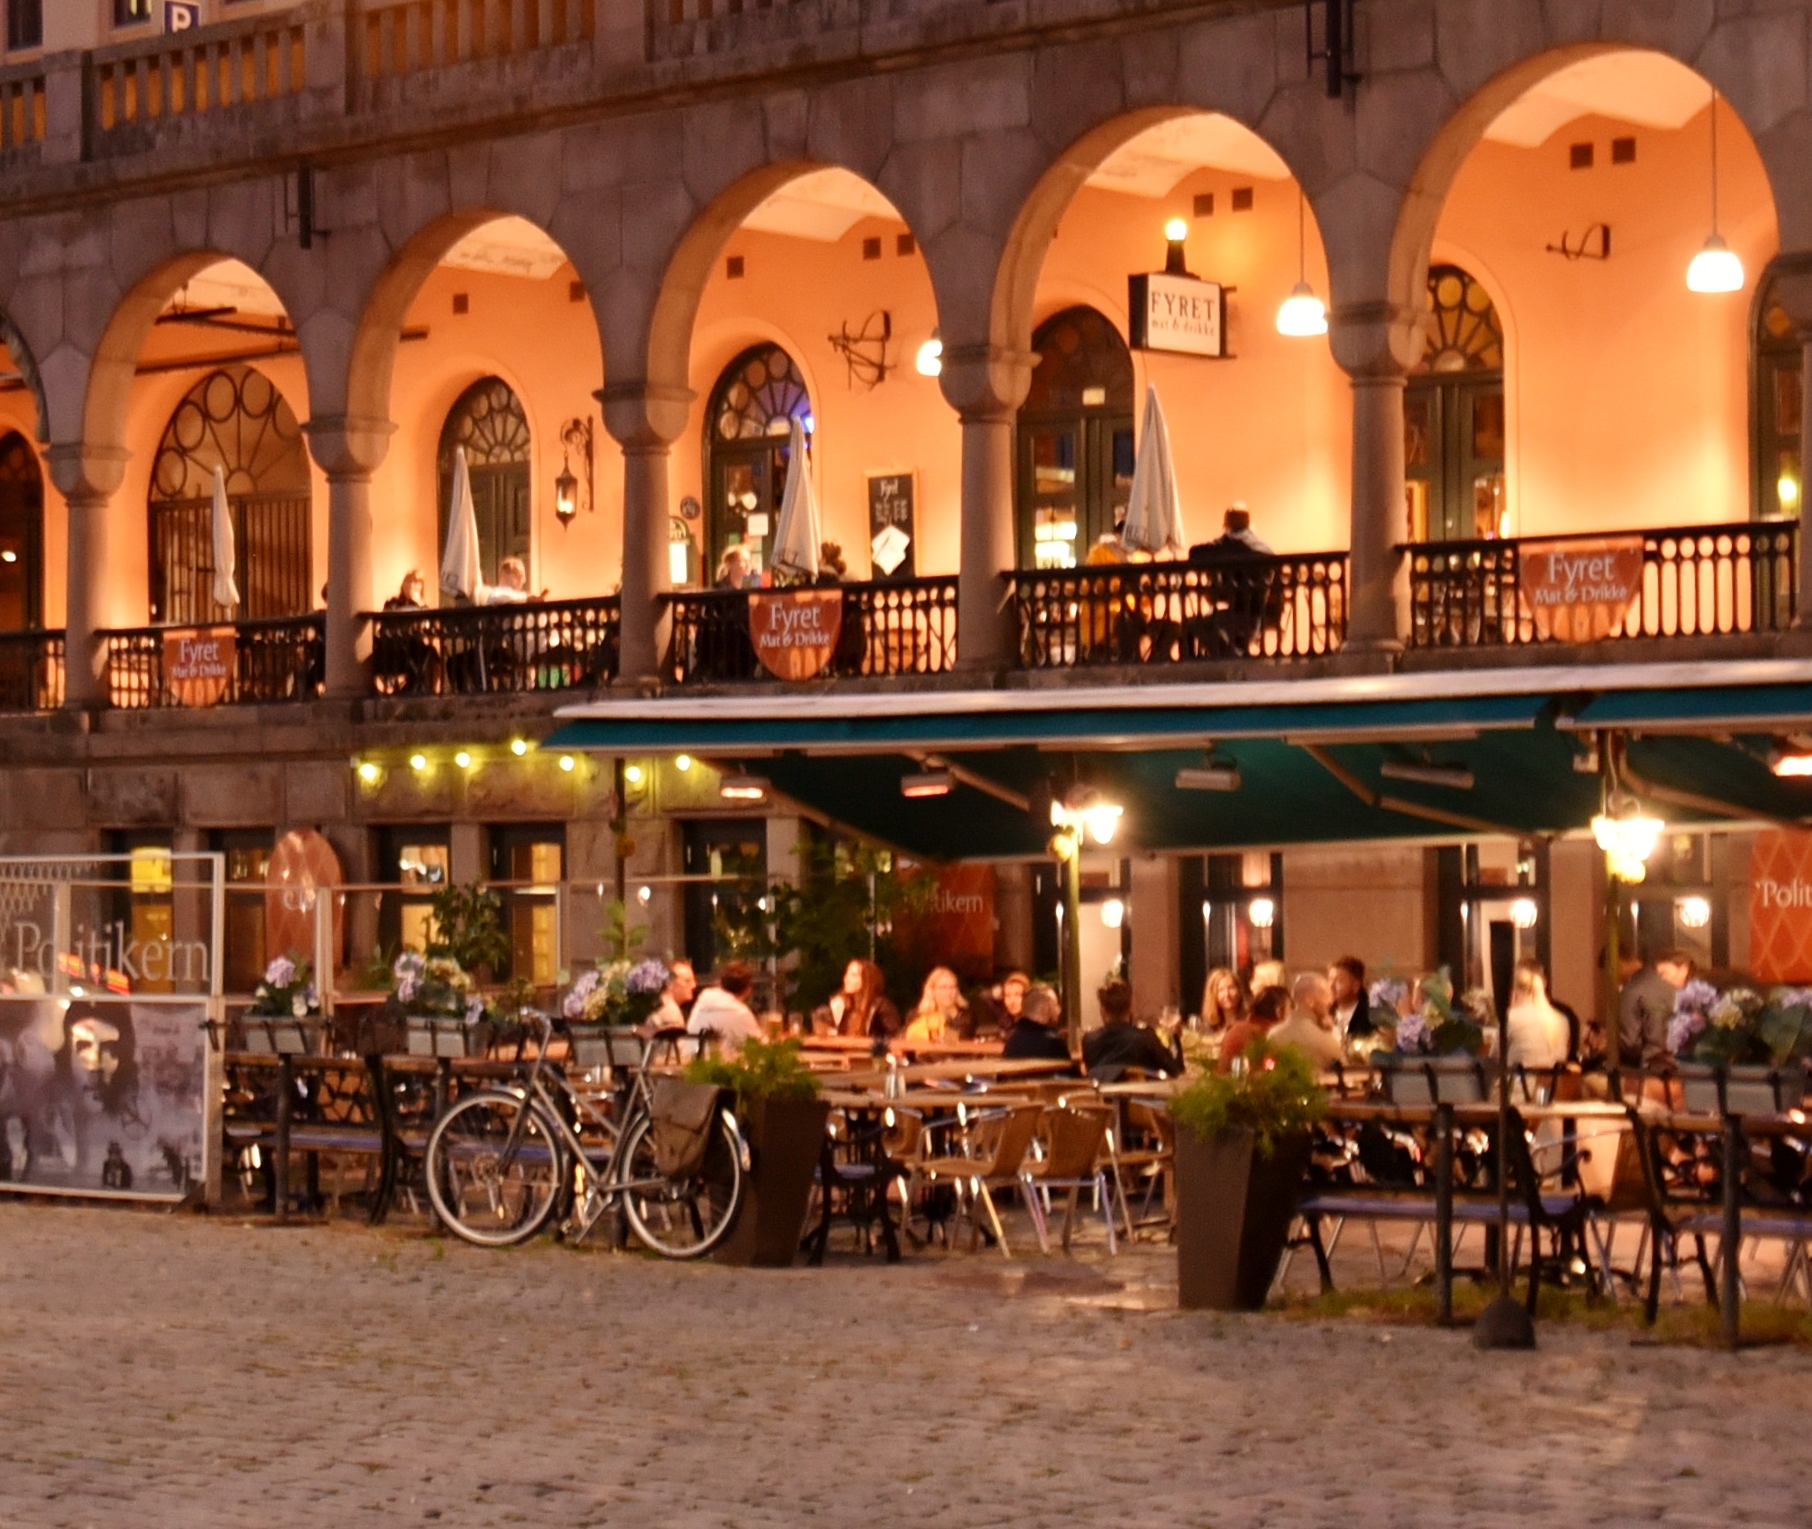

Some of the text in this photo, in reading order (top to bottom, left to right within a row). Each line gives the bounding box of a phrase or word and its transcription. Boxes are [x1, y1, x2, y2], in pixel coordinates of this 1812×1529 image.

[172, 6, 192, 32] P
[1151, 291, 1215, 321] FYRET
[1549, 552, 1615, 590] Fyret
[1534, 584, 1628, 605] Mat & Drikke
[771, 601, 821, 638] Fyret
[180, 639, 220, 668] Fyret
[759, 630, 831, 649] Mat & Drikke
[14, 919, 210, 981] Poitikern
